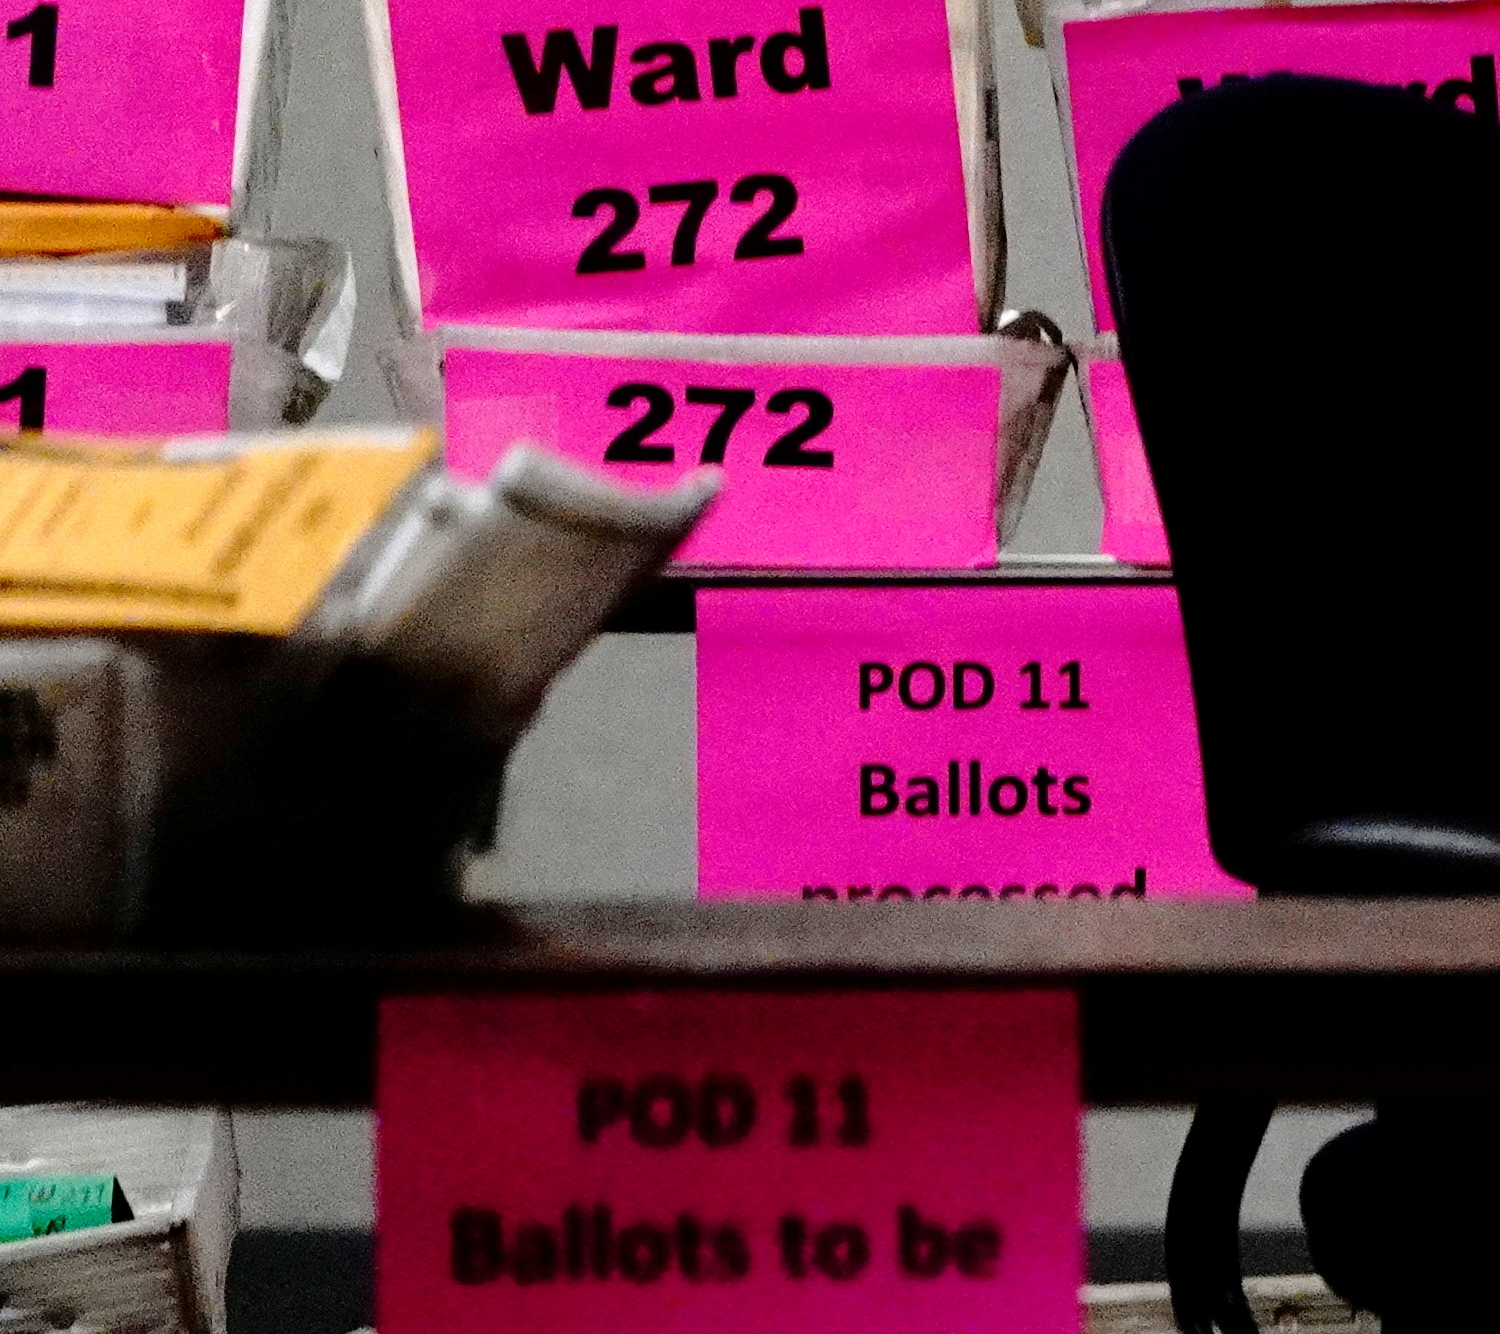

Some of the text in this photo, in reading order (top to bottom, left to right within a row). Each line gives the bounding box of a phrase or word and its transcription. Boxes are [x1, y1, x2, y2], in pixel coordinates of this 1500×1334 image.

[502, 7, 830, 114] Ward
[572, 174, 803, 275] 272
[605, 383, 833, 468] 272
[860, 662, 1088, 710] POD 11
[860, 760, 1090, 816] Ballots
[577, 1071, 870, 1148] POD 11
[449, 1203, 1001, 1285] Ballots to be
